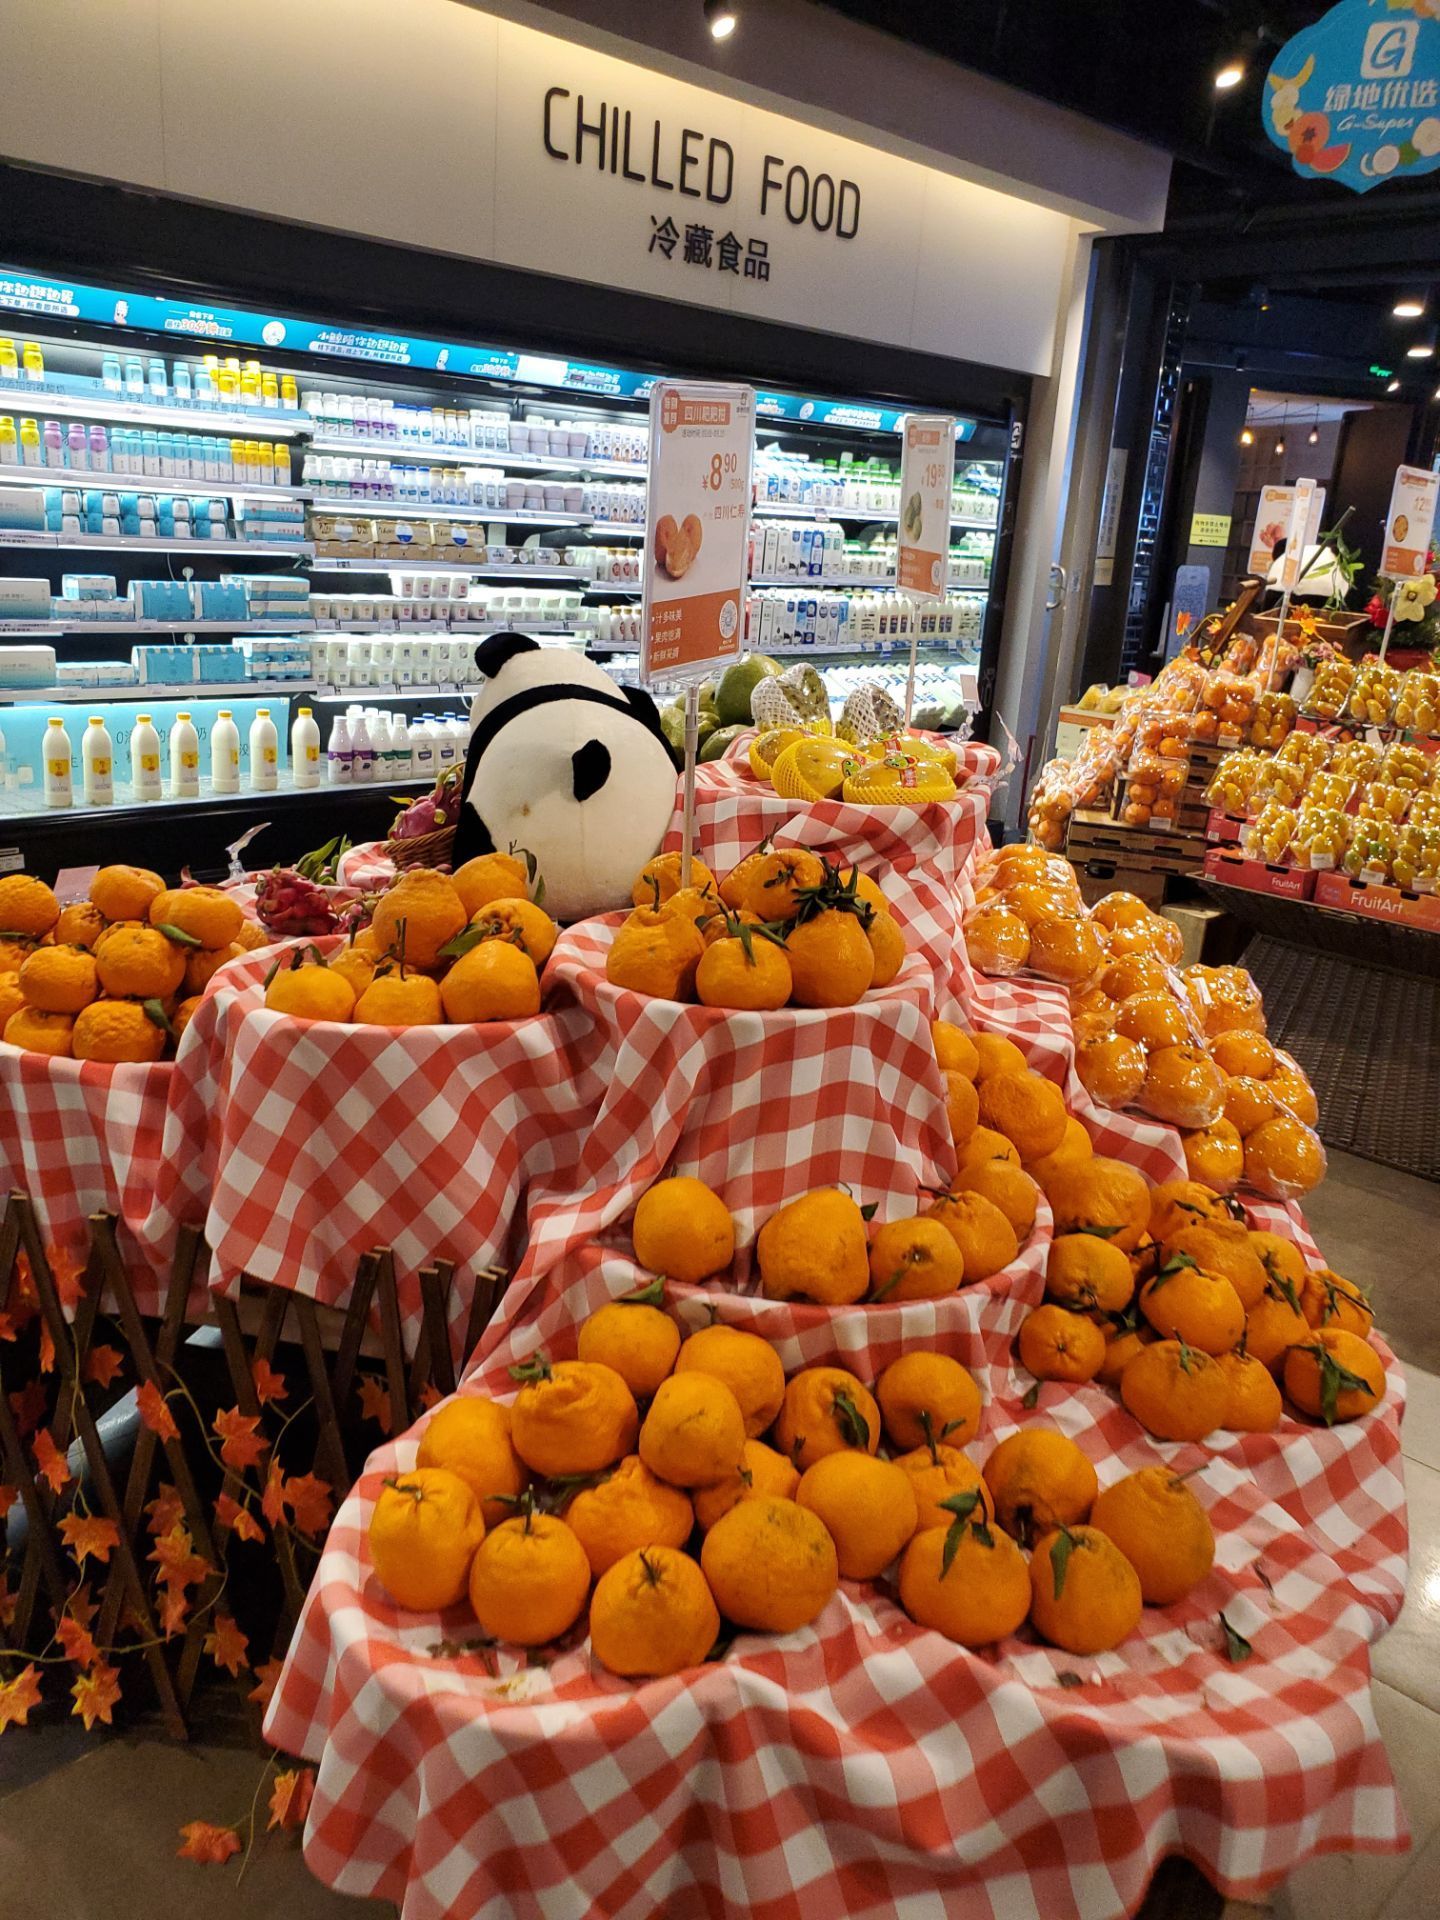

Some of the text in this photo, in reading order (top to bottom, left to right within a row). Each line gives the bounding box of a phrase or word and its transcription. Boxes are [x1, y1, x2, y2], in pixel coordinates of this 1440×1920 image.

[543, 86, 862, 240] CHILLED FOOD
[648, 214, 771, 283] 冷藏食品
[1271, 876, 1302, 891] FruitArt
[1350, 890, 1404, 915] FruitArt
